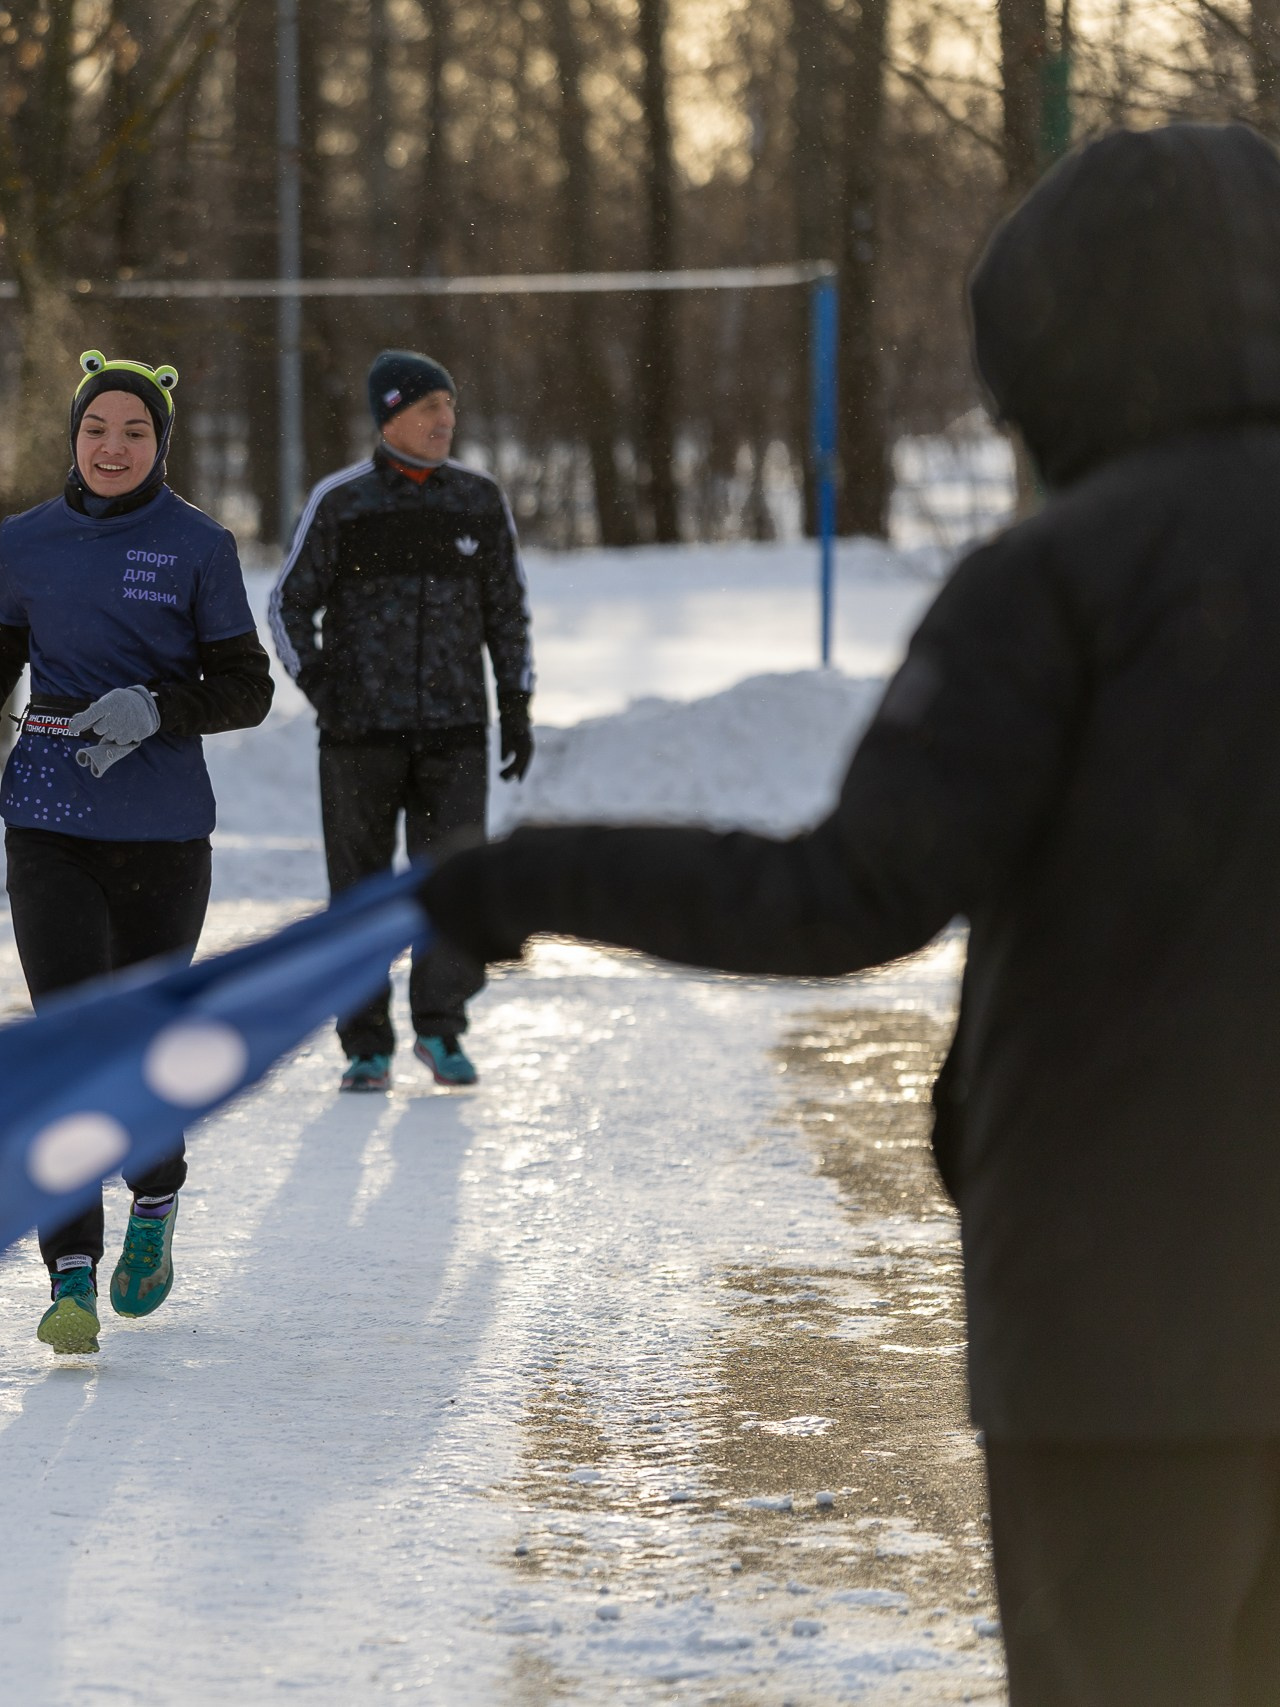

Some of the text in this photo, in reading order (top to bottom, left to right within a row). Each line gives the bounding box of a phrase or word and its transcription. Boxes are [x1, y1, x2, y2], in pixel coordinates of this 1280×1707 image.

[126, 549, 178, 568] спорт
[122, 568, 156, 582] для
[122, 587, 177, 605] жизни
